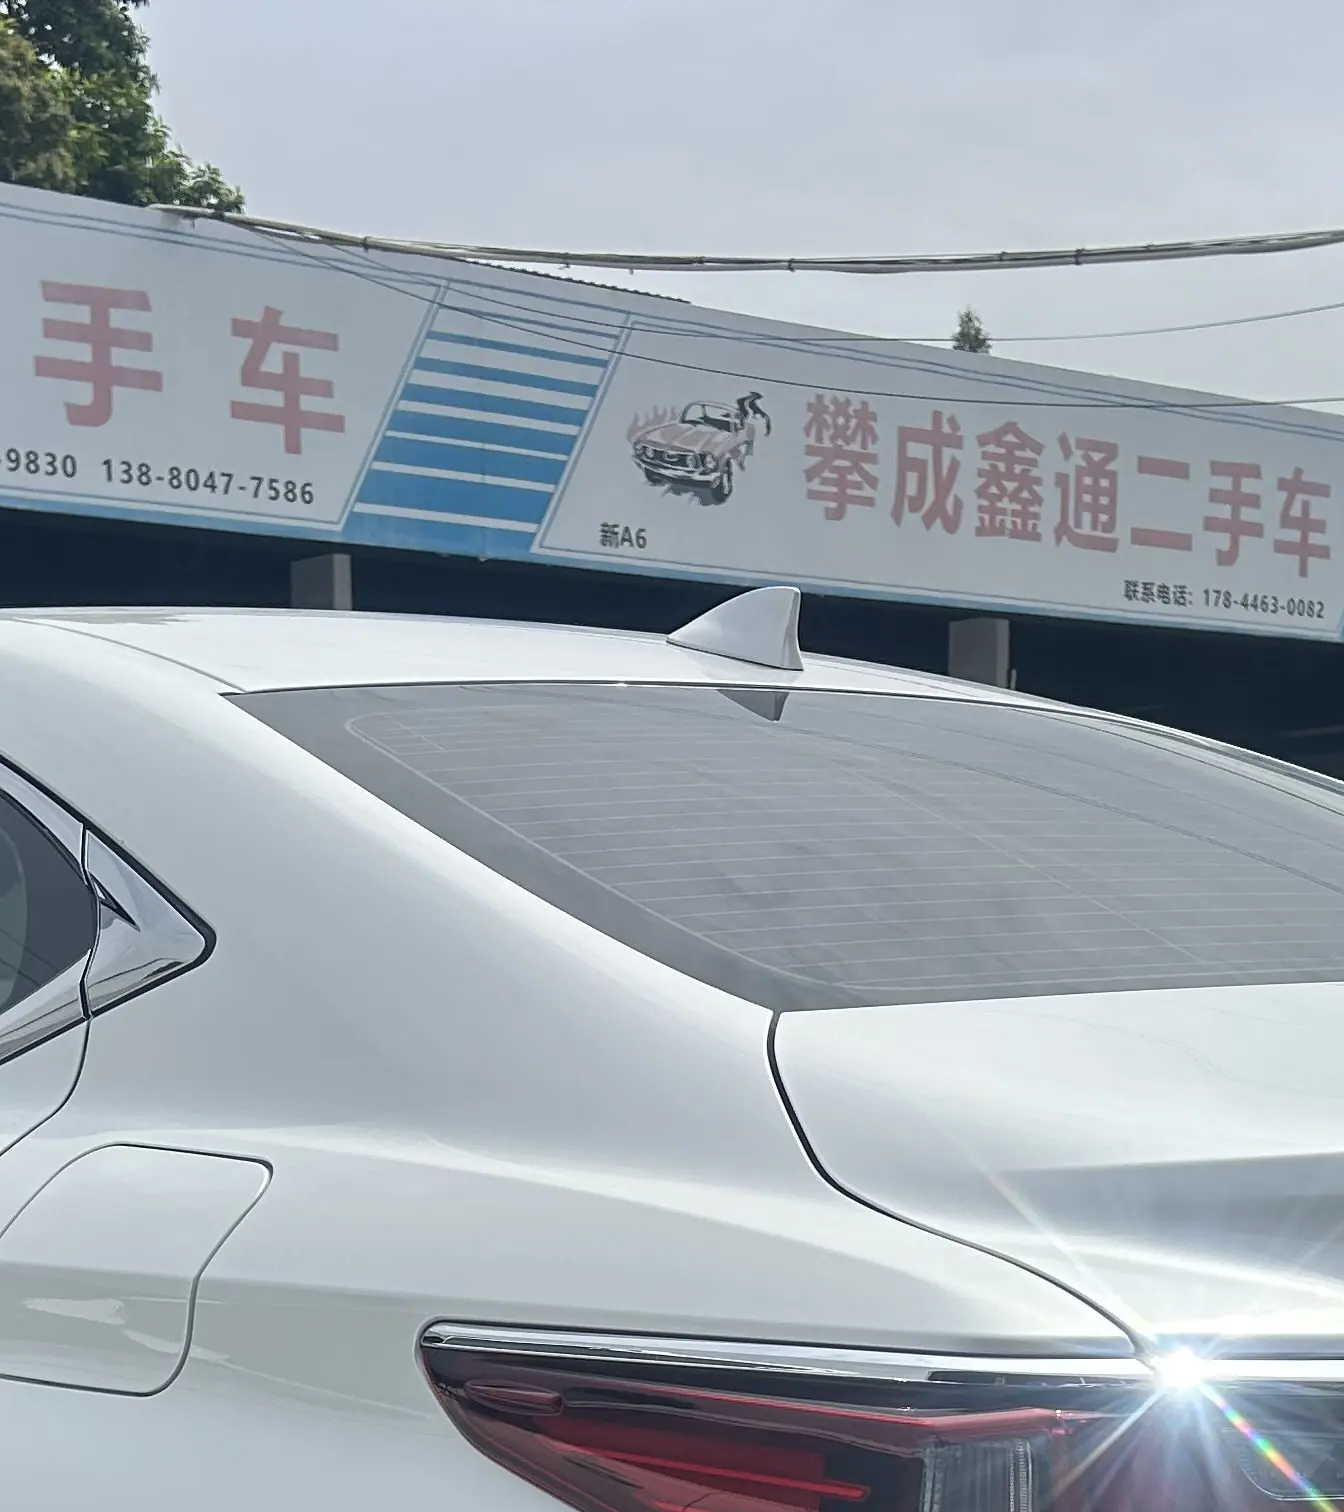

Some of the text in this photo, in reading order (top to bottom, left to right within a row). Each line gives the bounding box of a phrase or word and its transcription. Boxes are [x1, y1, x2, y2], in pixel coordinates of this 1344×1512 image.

[102, 457, 316, 506] 138-8047-7586
[802, 393, 1333, 579] 攀成鑫通二手车
[599, 521, 648, 549] 新A6
[1202, 588, 1326, 619] 178-4463-0082
